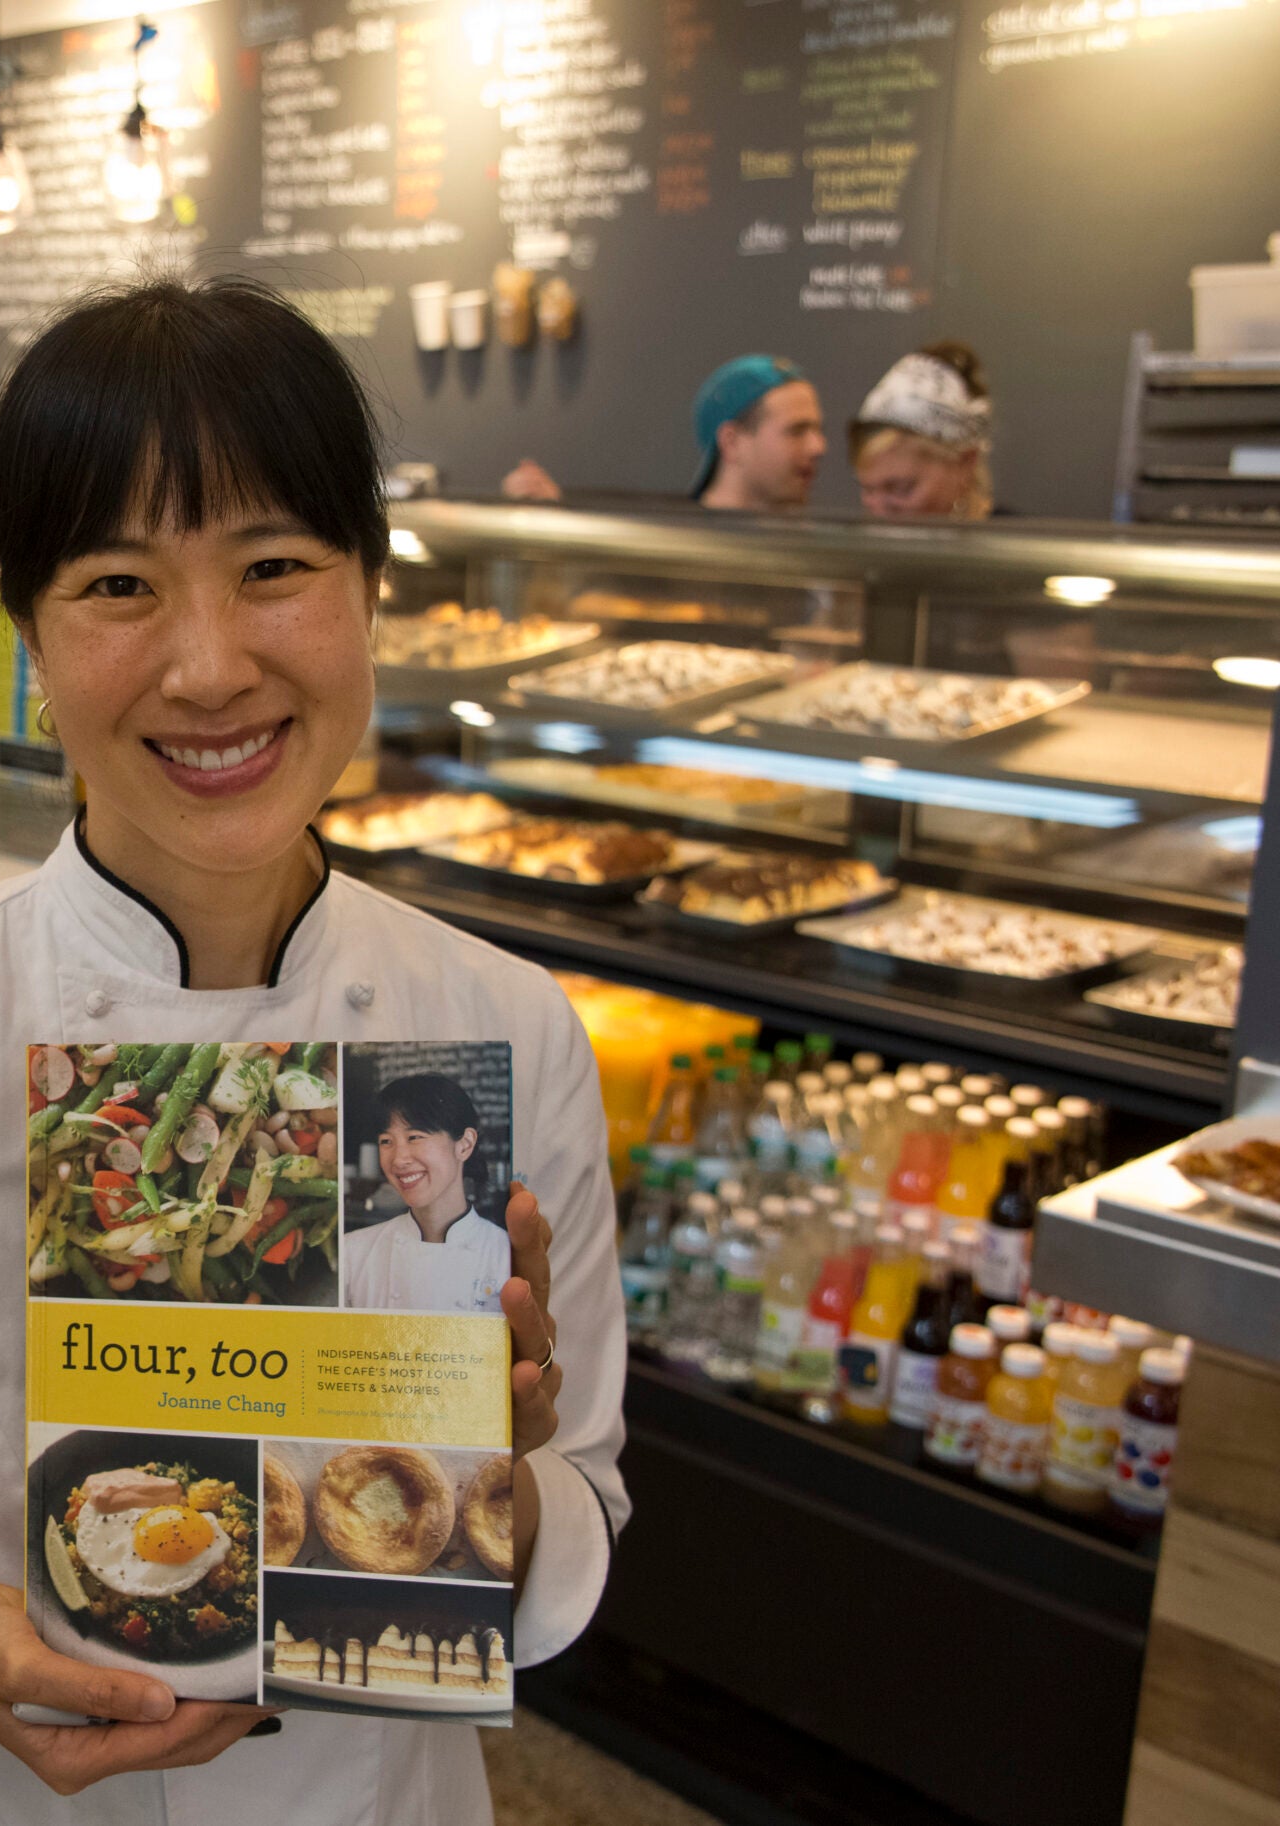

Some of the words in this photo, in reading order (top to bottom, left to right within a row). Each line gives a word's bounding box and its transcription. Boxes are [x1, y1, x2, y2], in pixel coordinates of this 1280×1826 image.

[62, 1322, 196, 1384] flour,
[211, 1340, 288, 1379] too
[317, 1349, 411, 1361] INDISPENSABLE
[415, 1353, 465, 1363] RECIPES
[470, 1354, 484, 1364] for
[318, 1365, 340, 1375] THE
[390, 1368, 423, 1378] MOST
[427, 1370, 468, 1380] LOVED
[317, 1381, 365, 1392] SWEETS
[369, 1384, 377, 1393] &
[381, 1384, 440, 1395] SAVORIES
[158, 1392, 222, 1410] Joanne
[227, 1395, 286, 1417] Chang
